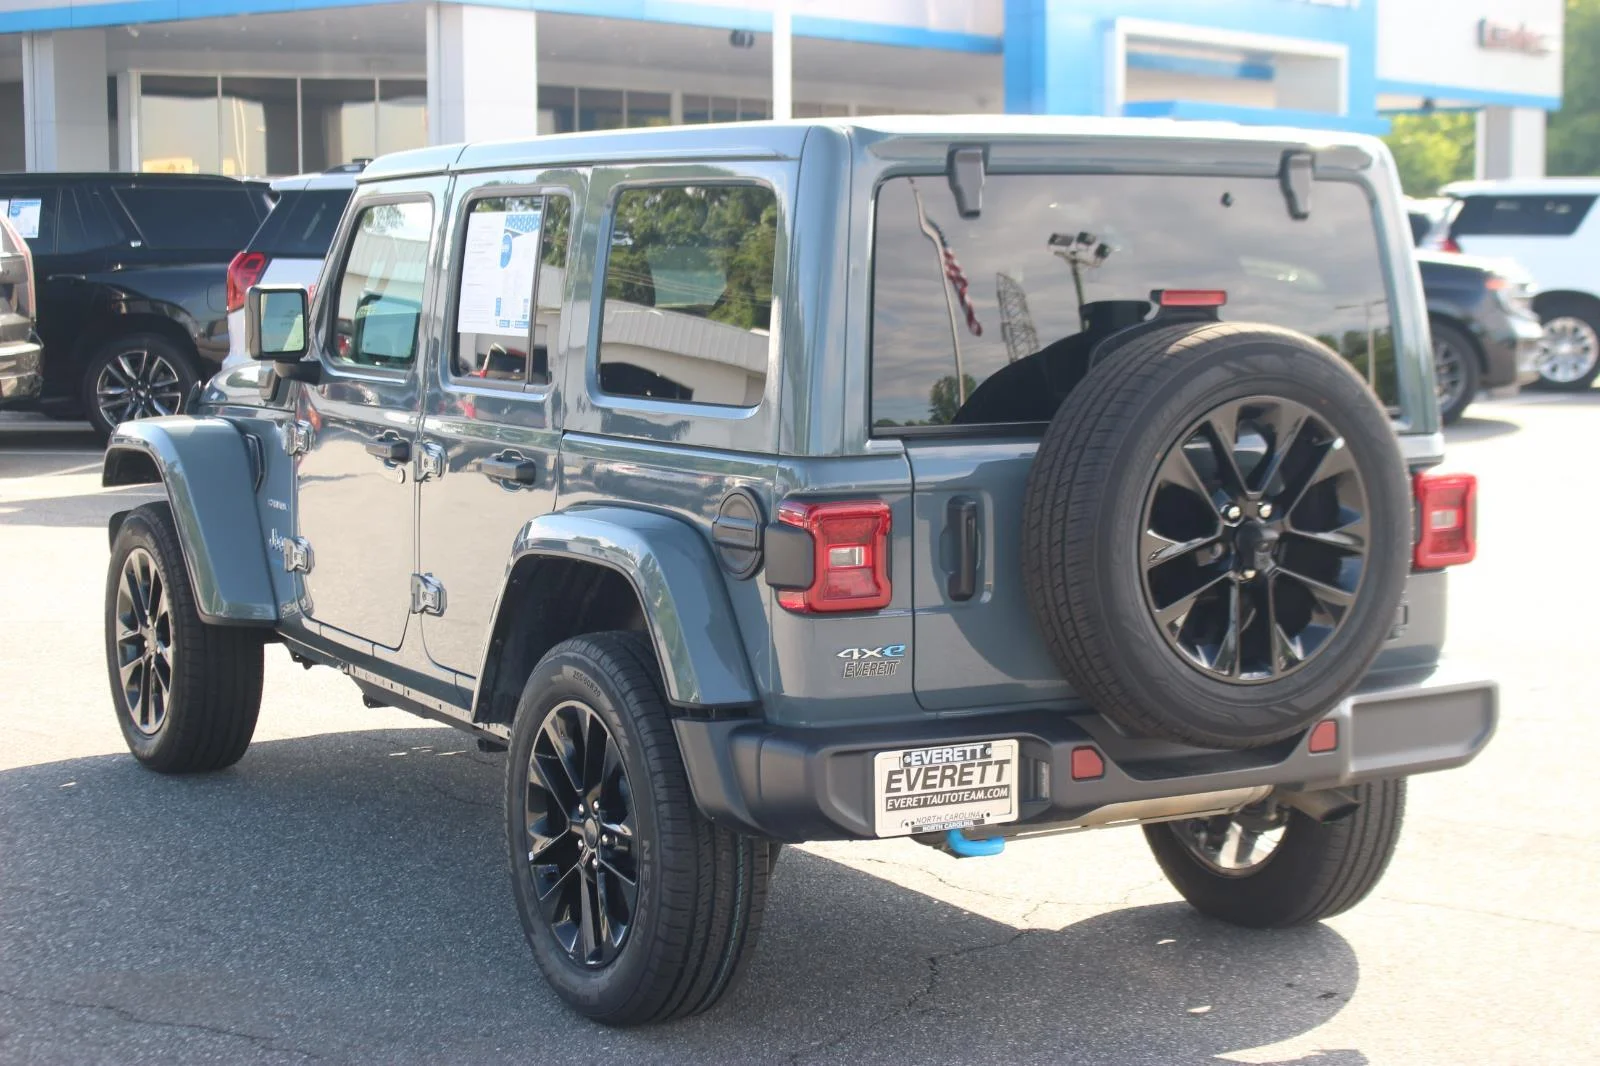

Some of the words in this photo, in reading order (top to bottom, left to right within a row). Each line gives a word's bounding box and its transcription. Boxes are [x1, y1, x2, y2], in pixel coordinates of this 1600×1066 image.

[843, 660, 900, 678] EVERETT
[910, 745, 985, 766] EVERETT
[885, 759, 1011, 793] EVERETT
[886, 787, 1009, 810] EVERETTAUTOTEAM.COM
[915, 815, 942, 825] NORTH
[944, 811, 981, 822] CAROLINA
[922, 823, 944, 832] NORTH
[944, 820, 974, 829] CAROLINA
